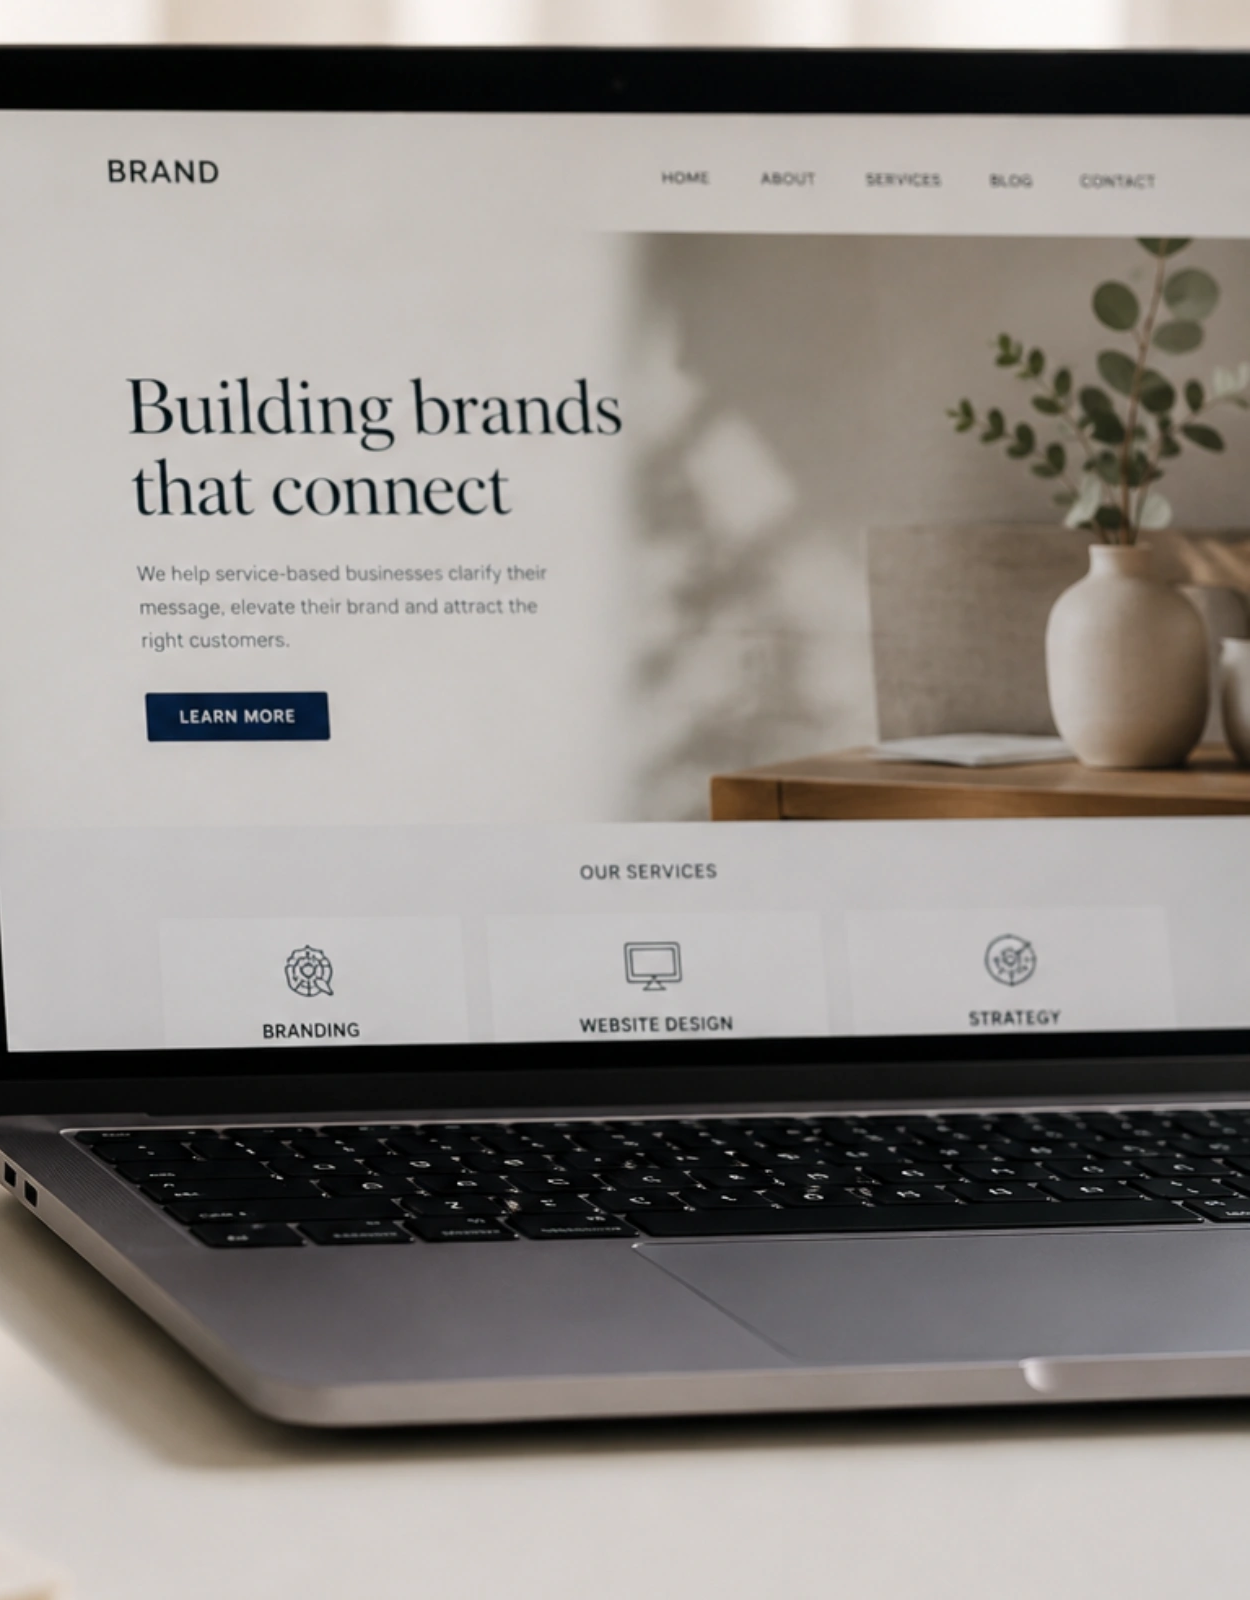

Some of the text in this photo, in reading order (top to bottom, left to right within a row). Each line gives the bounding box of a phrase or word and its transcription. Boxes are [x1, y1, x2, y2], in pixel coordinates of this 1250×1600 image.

[107, 159, 219, 184] BRAND
[661, 171, 708, 185] HOME
[761, 171, 815, 186] ABOUT
[866, 173, 943, 188] SERVICES
[989, 173, 1033, 188] BLOG
[1080, 174, 1155, 189] CONTACT
[126, 377, 623, 451] Building brands
[132, 457, 511, 516] that connect
[136, 563, 547, 586] We help service-based businesses clarify their
[139, 597, 538, 620] message, elevate their brand and attract the
[141, 631, 290, 653] right customers.
[179, 708, 295, 725] LEARN MORE
[579, 863, 718, 881] OUR SERVICES
[579, 1016, 732, 1034] WEBSITE DESIGN
[968, 1009, 1060, 1027] STRATEGY
[262, 1022, 360, 1040] BRANDING
